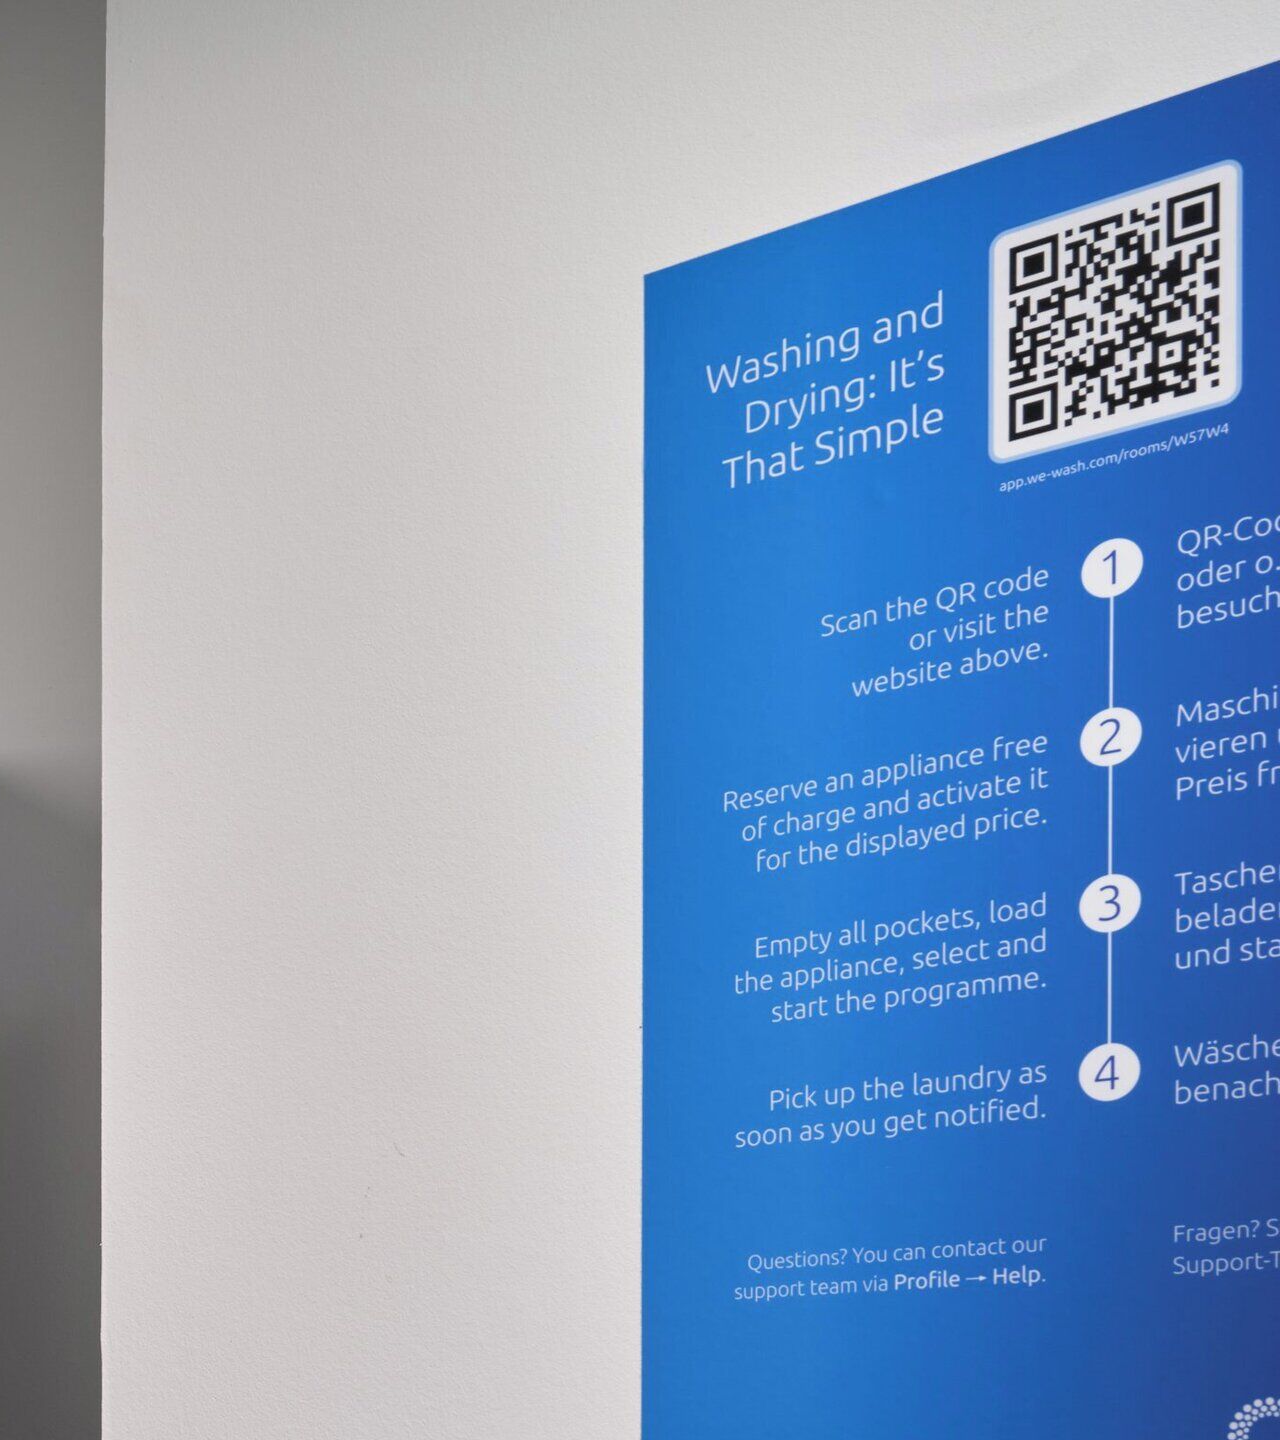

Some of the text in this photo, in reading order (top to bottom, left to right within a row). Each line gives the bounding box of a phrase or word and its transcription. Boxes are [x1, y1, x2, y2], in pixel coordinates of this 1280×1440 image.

[705, 289, 944, 394] Washing and
[745, 349, 945, 434] Drying: It's
[721, 402, 945, 489] That Simple
[998, 421, 1232, 494] app.we-wash.com/rooms/W57W4
[1101, 549, 1119, 586] 1
[1176, 559, 1247, 592] oder
[820, 565, 1050, 638] Scan the QR code
[908, 603, 1049, 651] or visit the
[851, 642, 1049, 698] website above.
[1099, 718, 1122, 756] 2
[1174, 731, 1267, 764] vieren
[723, 735, 1049, 813] Reserve an appliance free
[1176, 768, 1248, 801] Preis
[741, 767, 1049, 842] of charge and activate it
[756, 807, 1047, 873] for the displayed price.
[1173, 861, 1280, 896] Tasche
[755, 891, 1047, 959] Empty all pockets, load
[1097, 885, 1122, 922] 3
[1175, 897, 1280, 934] belade
[734, 927, 1047, 995] the appliance, select and
[1175, 938, 1231, 970] und
[771, 971, 1047, 1023] start the programme.
[769, 1064, 1048, 1112] Pick up the laundry as
[1093, 1054, 1120, 1091] 4
[735, 1094, 1046, 1149] soon as you get notified.
[747, 1238, 1048, 1274] Questions? You can contact our
[1173, 1219, 1261, 1245] Fragen?
[734, 1264, 1046, 1303] support team via Profile Help.
